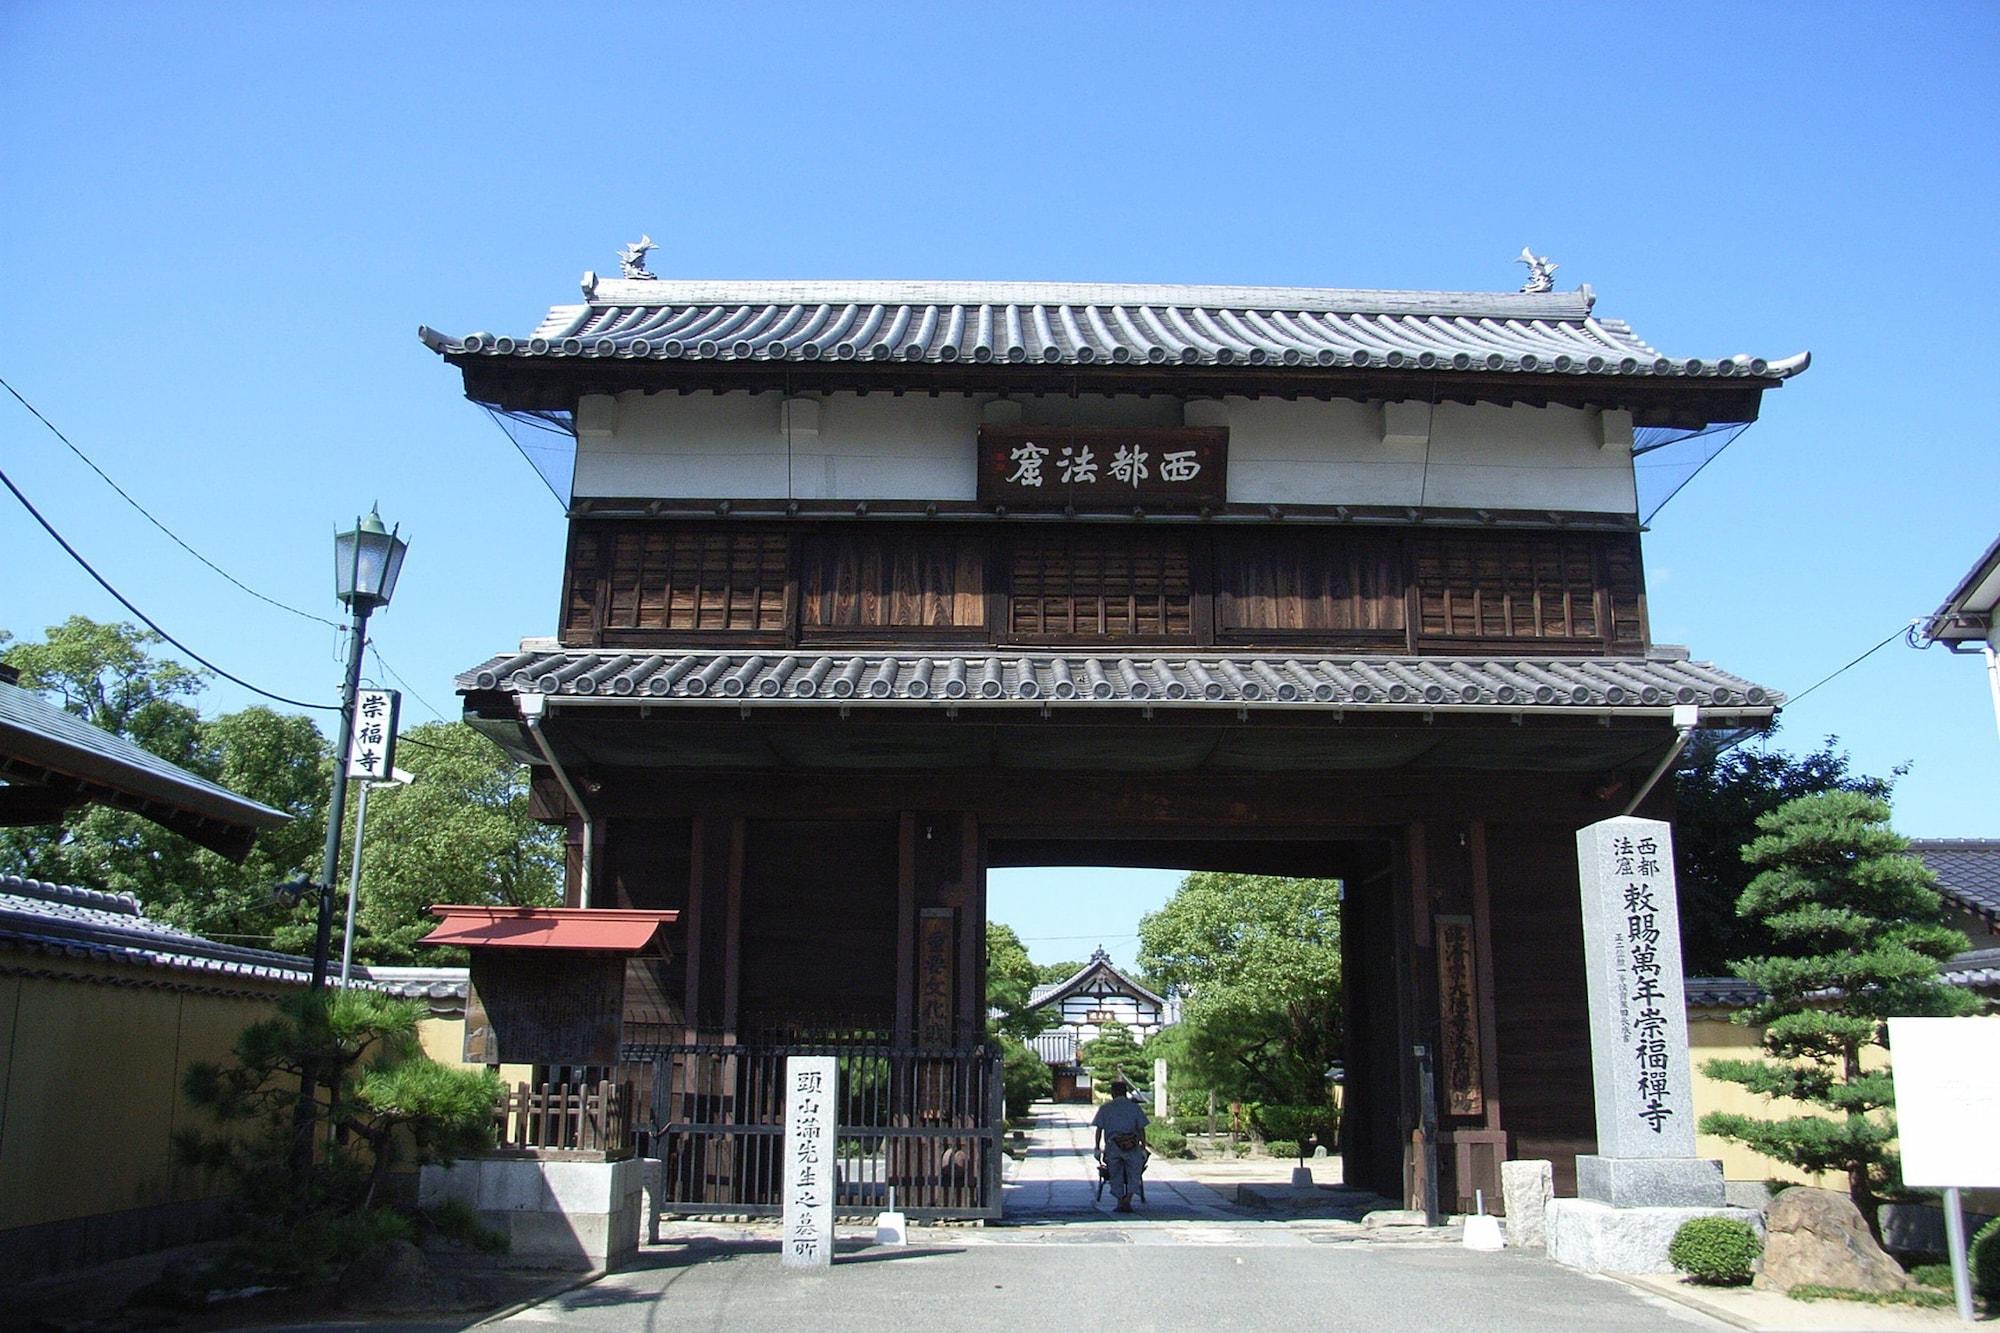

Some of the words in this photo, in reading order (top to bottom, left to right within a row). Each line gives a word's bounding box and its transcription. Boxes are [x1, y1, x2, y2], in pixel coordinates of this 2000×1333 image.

[356, 695, 387, 772] 崇福寺
[1613, 837, 1634, 876] 法窟
[1637, 837, 1660, 877] 西都
